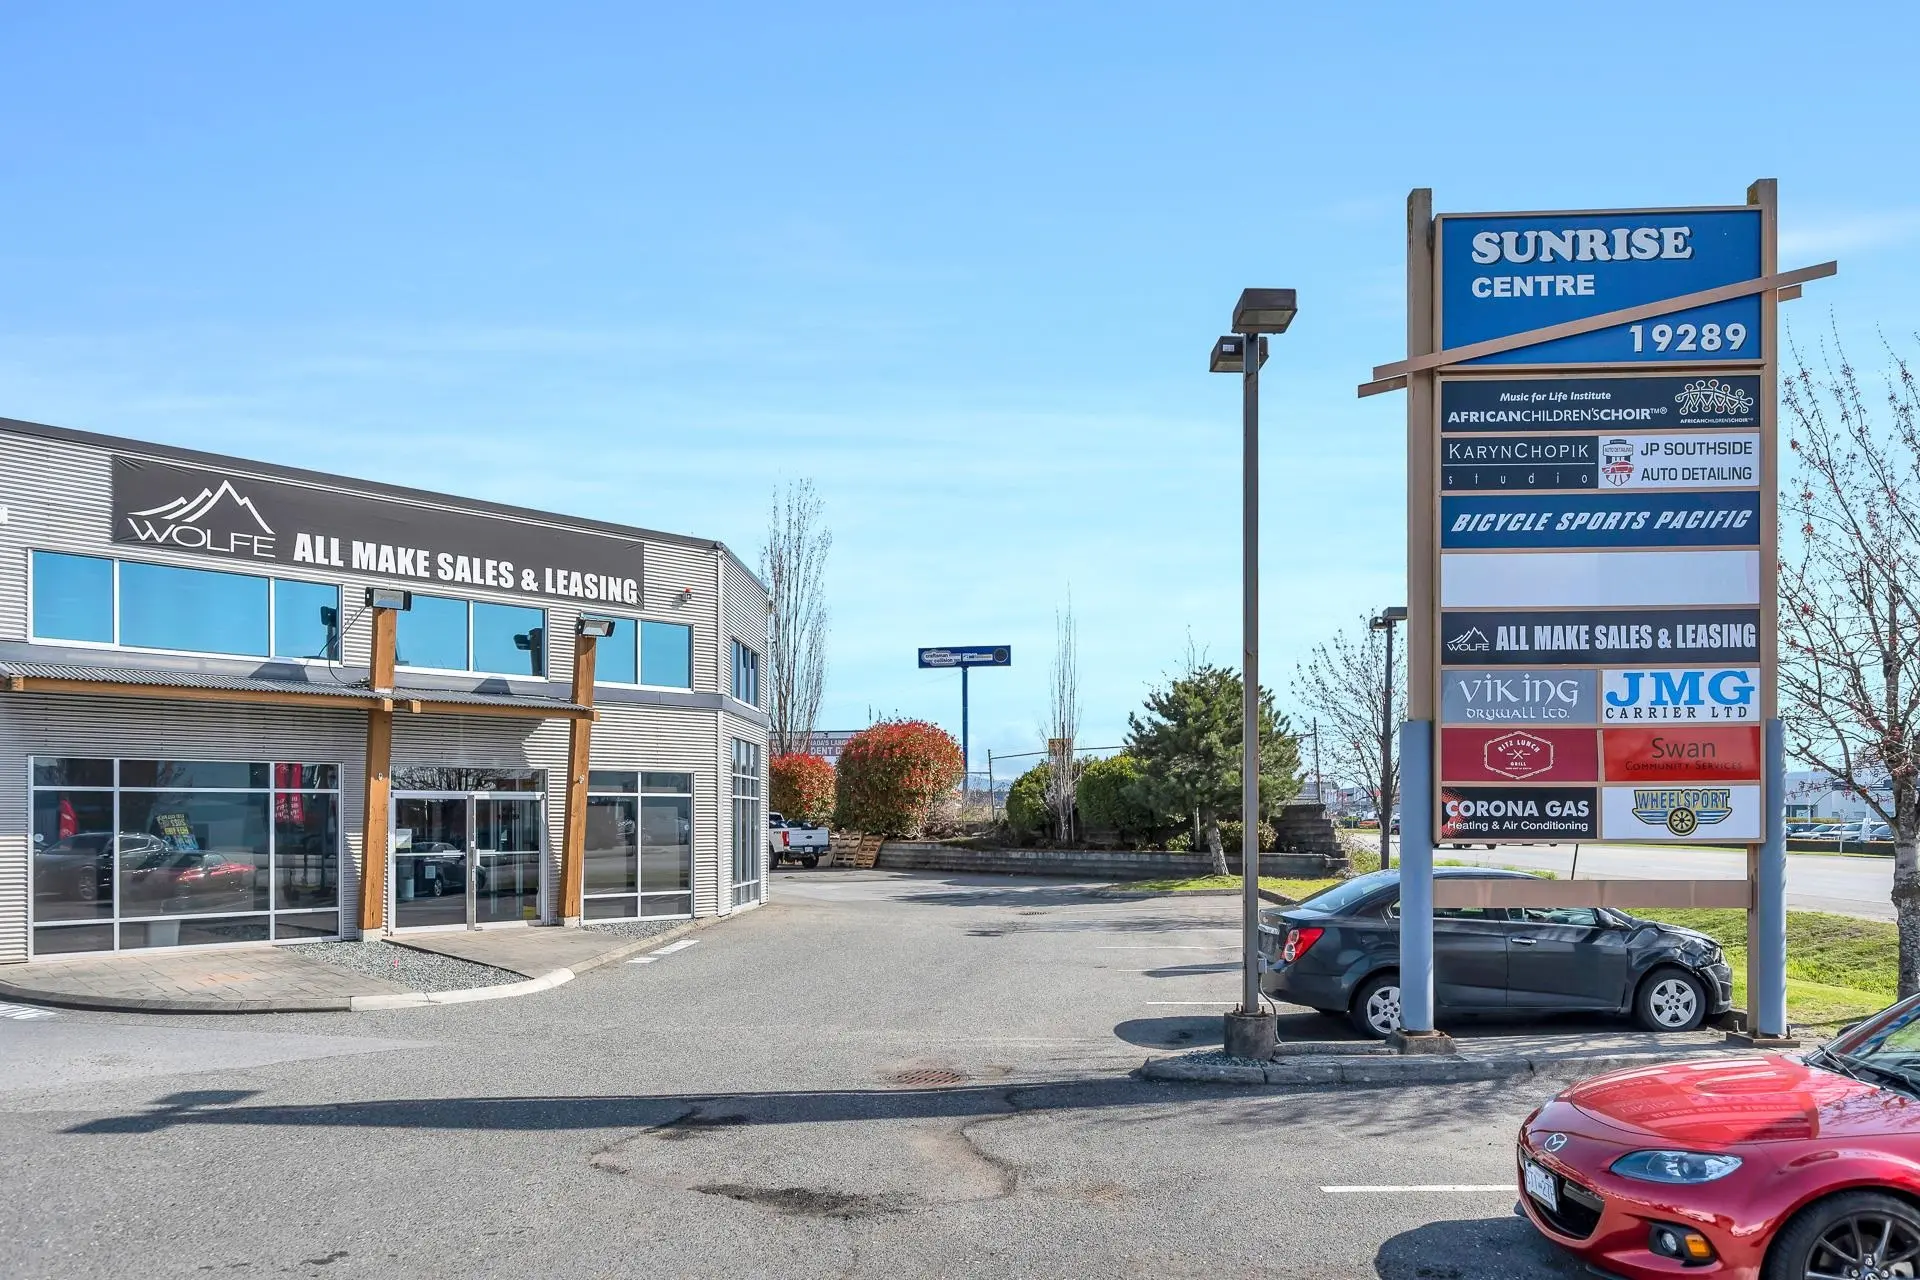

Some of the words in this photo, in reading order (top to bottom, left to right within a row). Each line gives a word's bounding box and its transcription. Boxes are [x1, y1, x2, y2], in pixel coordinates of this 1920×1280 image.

[1471, 226, 1693, 264] SUNRISE
[1471, 274, 1595, 298] CENTRE
[1629, 322, 1748, 353] 19289
[1499, 392, 1530, 402] Music
[1531, 392, 1547, 403] for
[1548, 391, 1568, 402] Life
[1570, 390, 1612, 401] Institute
[1448, 442, 1590, 460] KARYNCHOPIK
[1640, 443, 1660, 457] JP
[1664, 440, 1753, 456] SOUTHSIDE
[1640, 468, 1678, 482] AUTO
[1681, 466, 1752, 481] DETAILING
[1451, 512, 1553, 533] BICYCLE
[1556, 511, 1651, 532] SPORTS
[1653, 509, 1753, 530] PACIFIC
[126, 516, 276, 558] WOLFE
[293, 532, 344, 568] ALL
[352, 541, 431, 578] MAKE
[436, 551, 515, 590] SALES
[520, 567, 540, 593] &
[545, 567, 640, 606] LEASING
[1495, 624, 1530, 651] ALL
[1534, 624, 1590, 650] MAKE
[1594, 623, 1653, 650] SALES
[1657, 630, 1672, 649] &
[1676, 622, 1757, 648] LEASING
[1447, 643, 1490, 652] WOLFE
[1606, 670, 1756, 707] JMG
[1605, 707, 1697, 719] CARRIER
[1711, 706, 1748, 718] LTD
[1497, 740, 1514, 753] RITZ
[1516, 739, 1541, 753] LUNCH
[1651, 737, 1716, 758] Swan
[1625, 761, 1690, 771] COMMUNITY
[1695, 760, 1743, 770] SERVICES
[1445, 801, 1539, 818] CORONA
[1545, 800, 1590, 817] GAS
[1636, 791, 1729, 810] WHEELSPORT
[1447, 821, 1490, 831] Heating
[1491, 821, 1500, 830] &
[1503, 821, 1519, 830] Air
[1521, 820, 1589, 832] Conditioning
